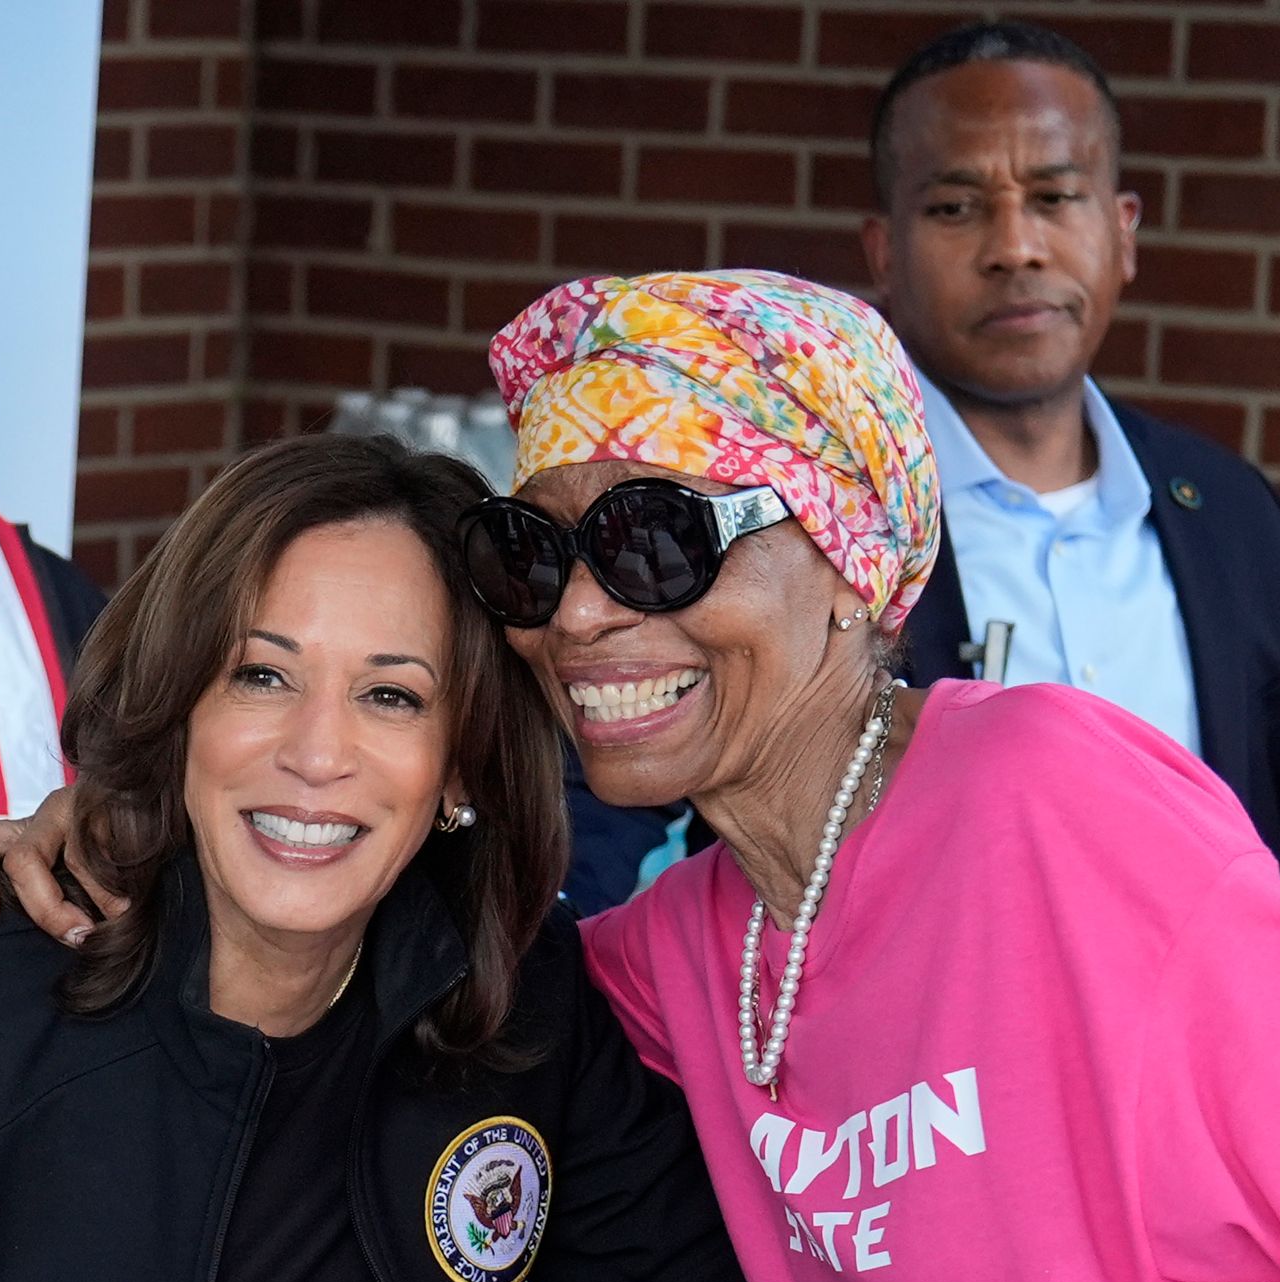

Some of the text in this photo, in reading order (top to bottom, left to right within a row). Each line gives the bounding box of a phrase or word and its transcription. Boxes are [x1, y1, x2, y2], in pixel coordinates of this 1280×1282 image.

[433, 1155, 461, 1257] PRESIDENT
[463, 1137, 480, 1156] OF
[483, 1128, 508, 1145] THE
[513, 1129, 546, 1177] UNITED
